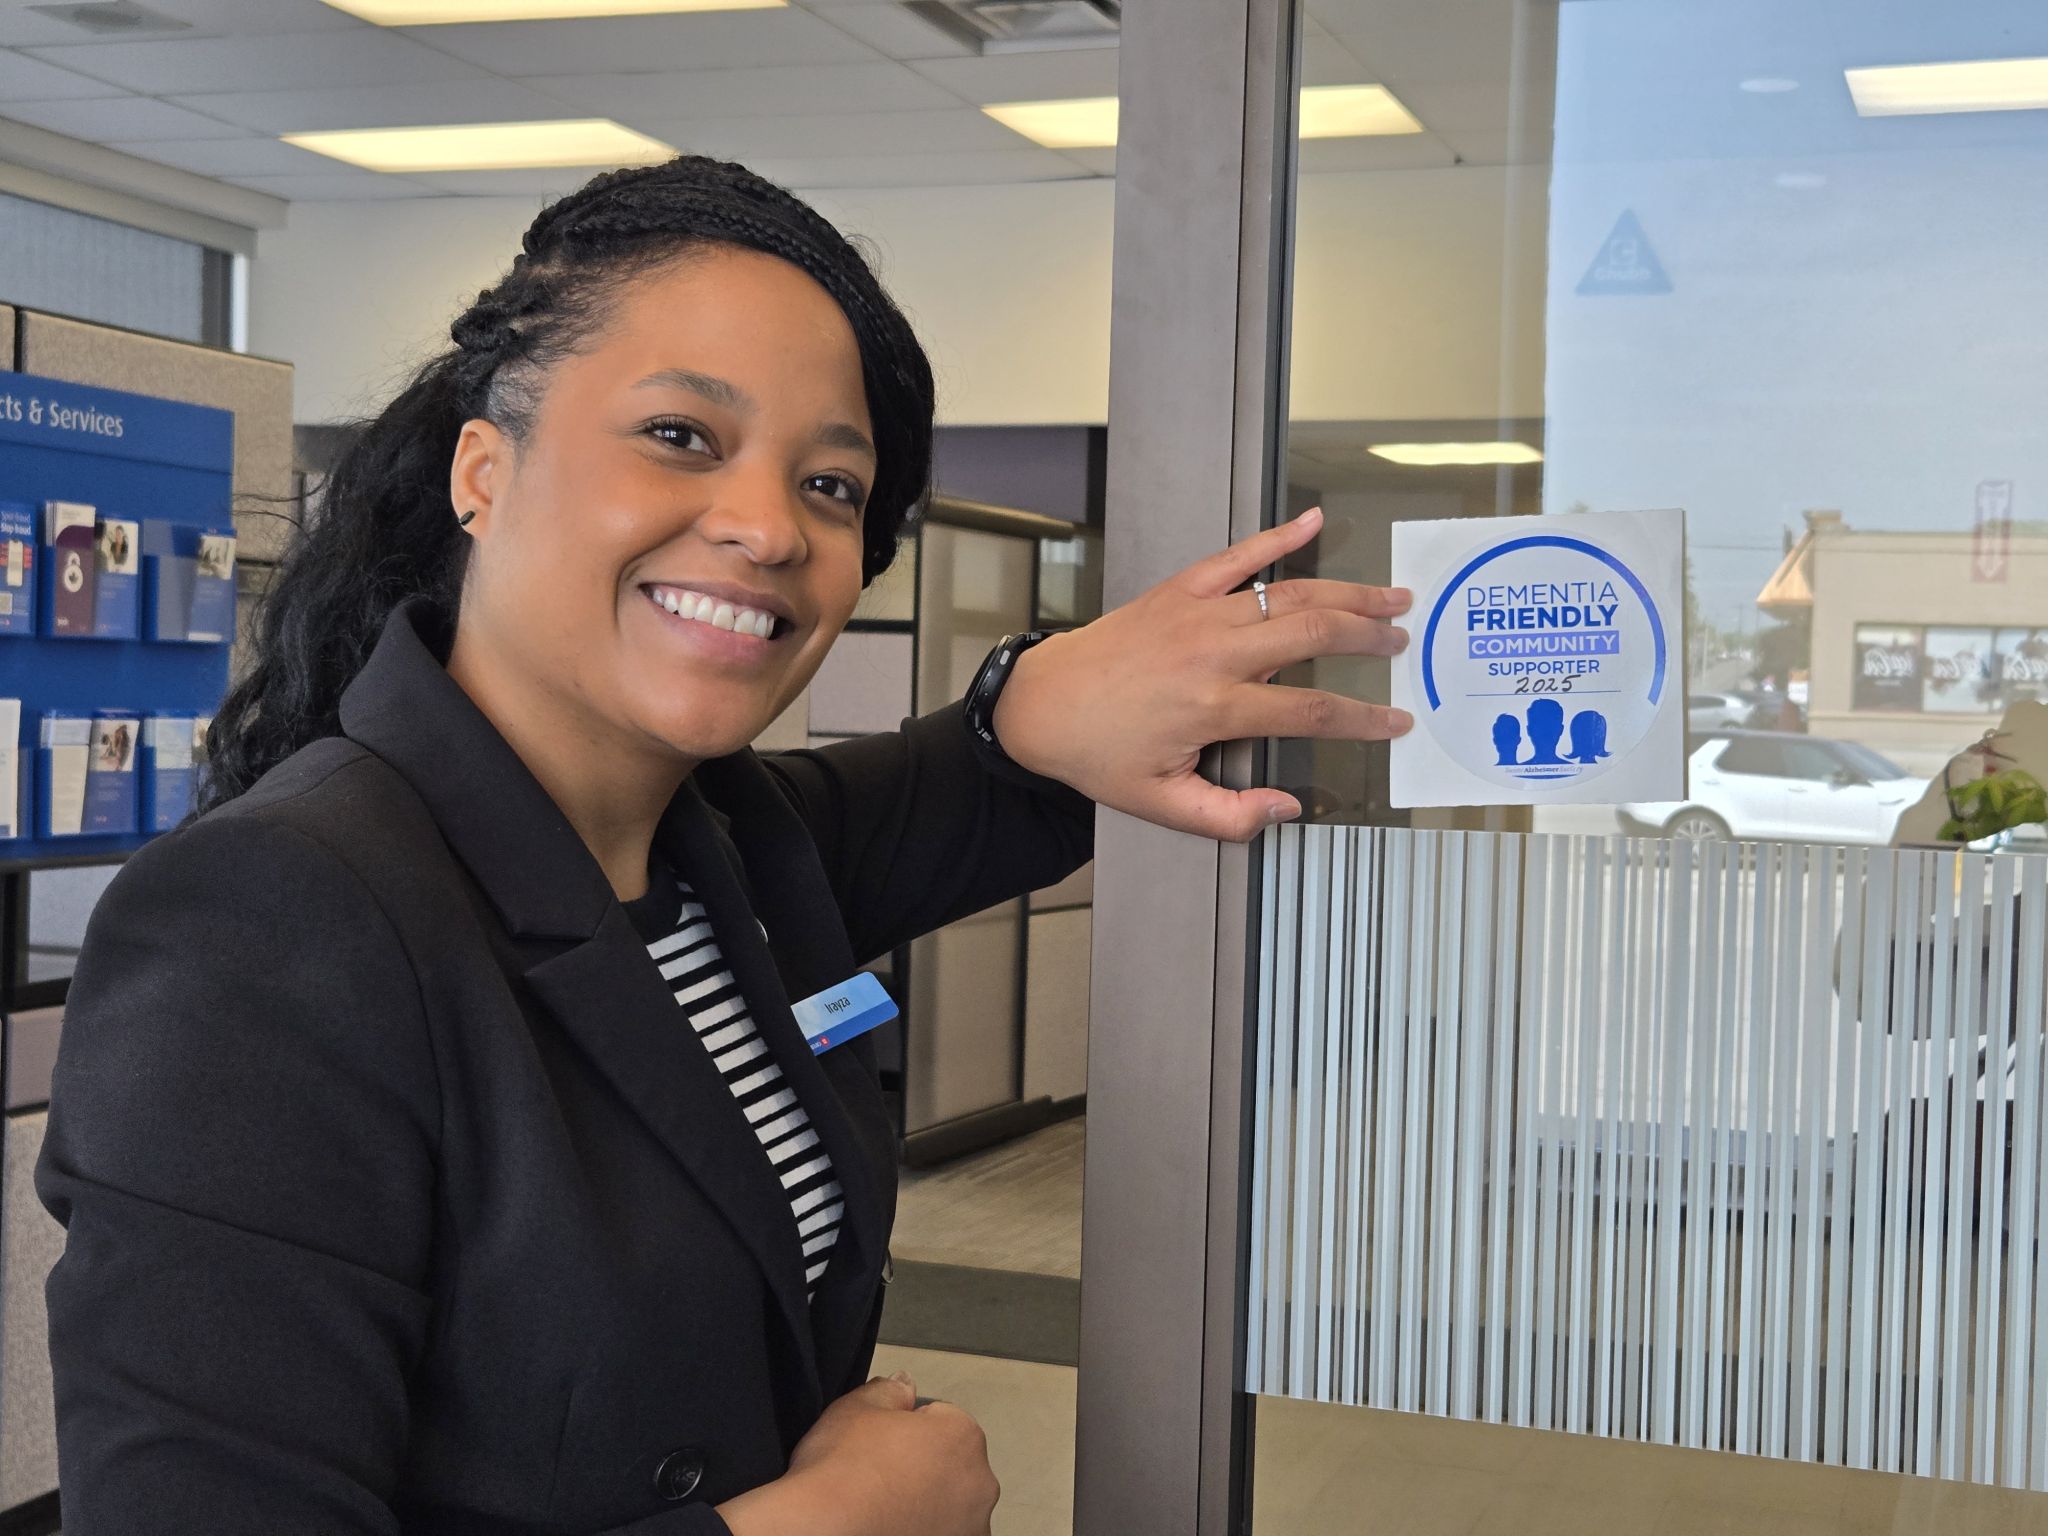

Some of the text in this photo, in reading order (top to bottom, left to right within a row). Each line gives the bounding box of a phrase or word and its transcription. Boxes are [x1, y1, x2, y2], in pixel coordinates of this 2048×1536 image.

[29, 397, 43, 424] &
[49, 400, 124, 438] Services
[1467, 581, 1619, 608] DEMENTIA
[1467, 604, 1618, 631] FRIENDLY
[1471, 634, 1616, 655] COMMUNITY
[1488, 659, 1600, 676] SUPPORTER
[1514, 674, 1581, 695] 2025
[824, 996, 851, 1014] Irayza
